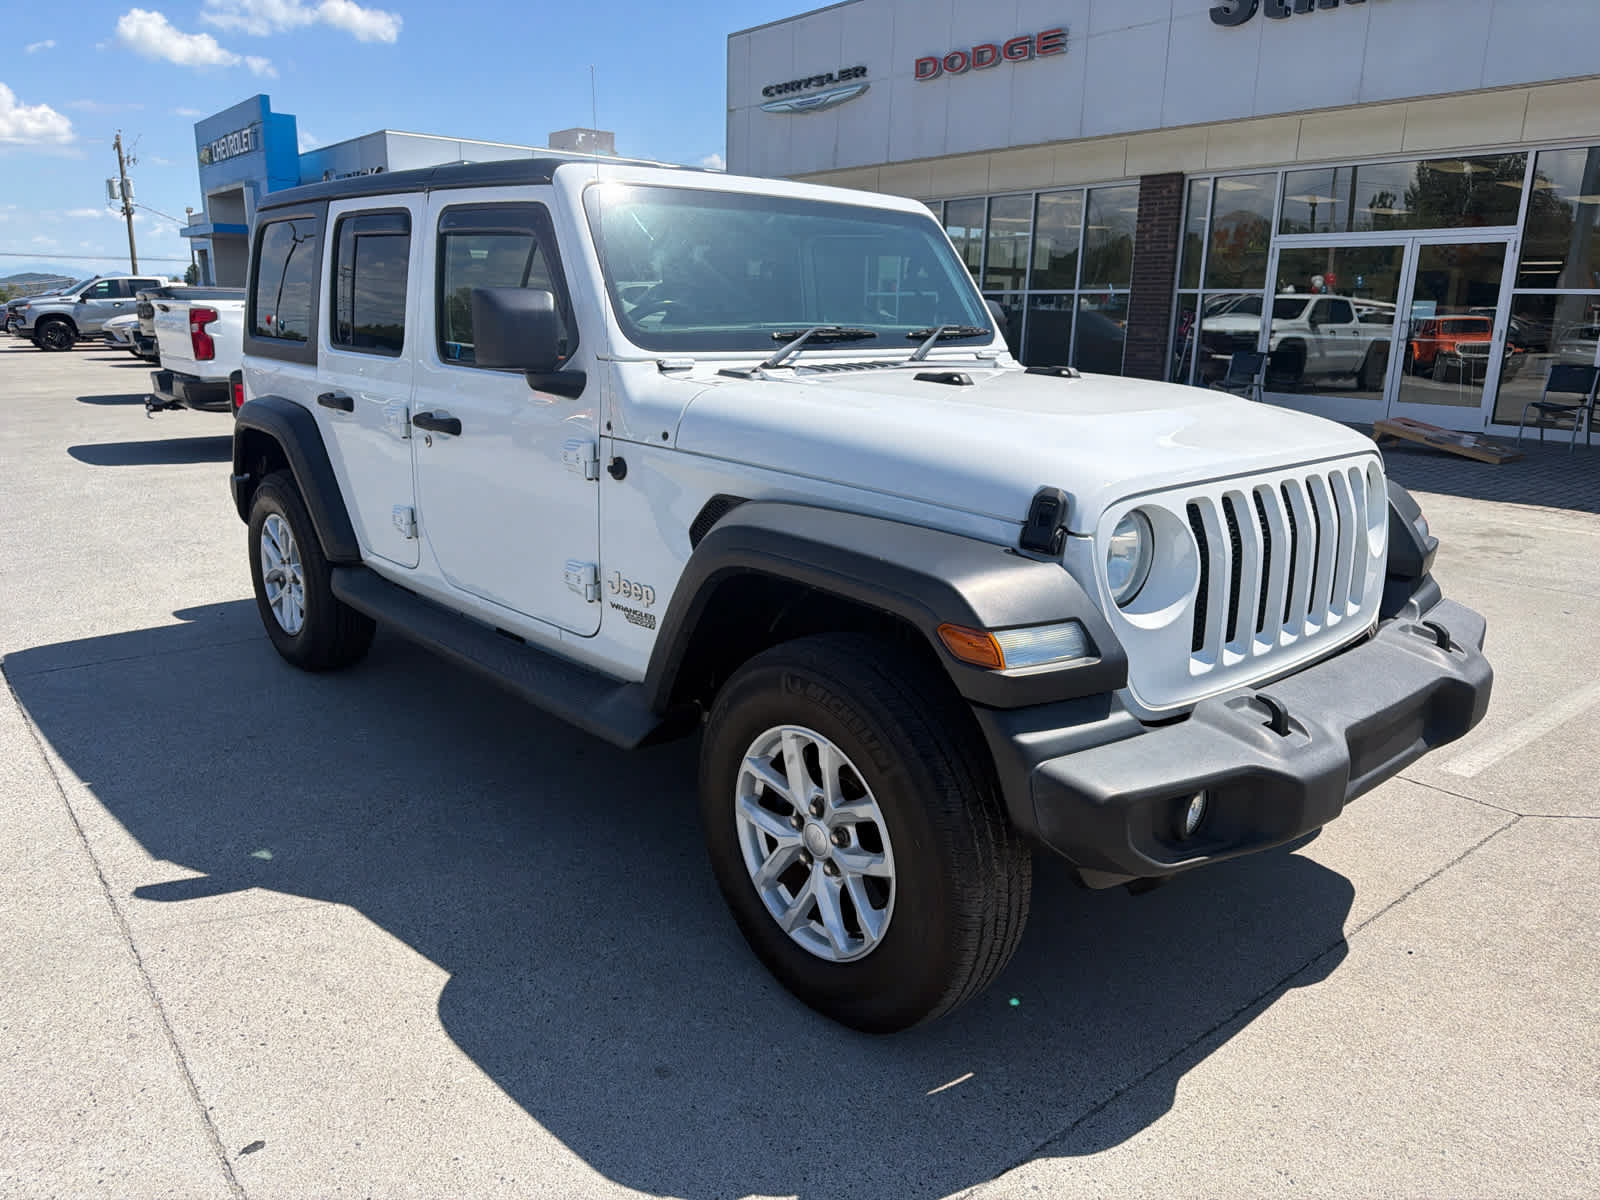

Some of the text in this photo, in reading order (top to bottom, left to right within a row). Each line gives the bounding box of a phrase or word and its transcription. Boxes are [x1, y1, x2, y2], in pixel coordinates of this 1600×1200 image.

[914, 27, 1067, 82] DODGE
[762, 65, 868, 97] CHRYSLER
[212, 128, 255, 162] CHEVROLET
[608, 570, 655, 609] Jeep
[609, 600, 656, 621] WRANGLER
